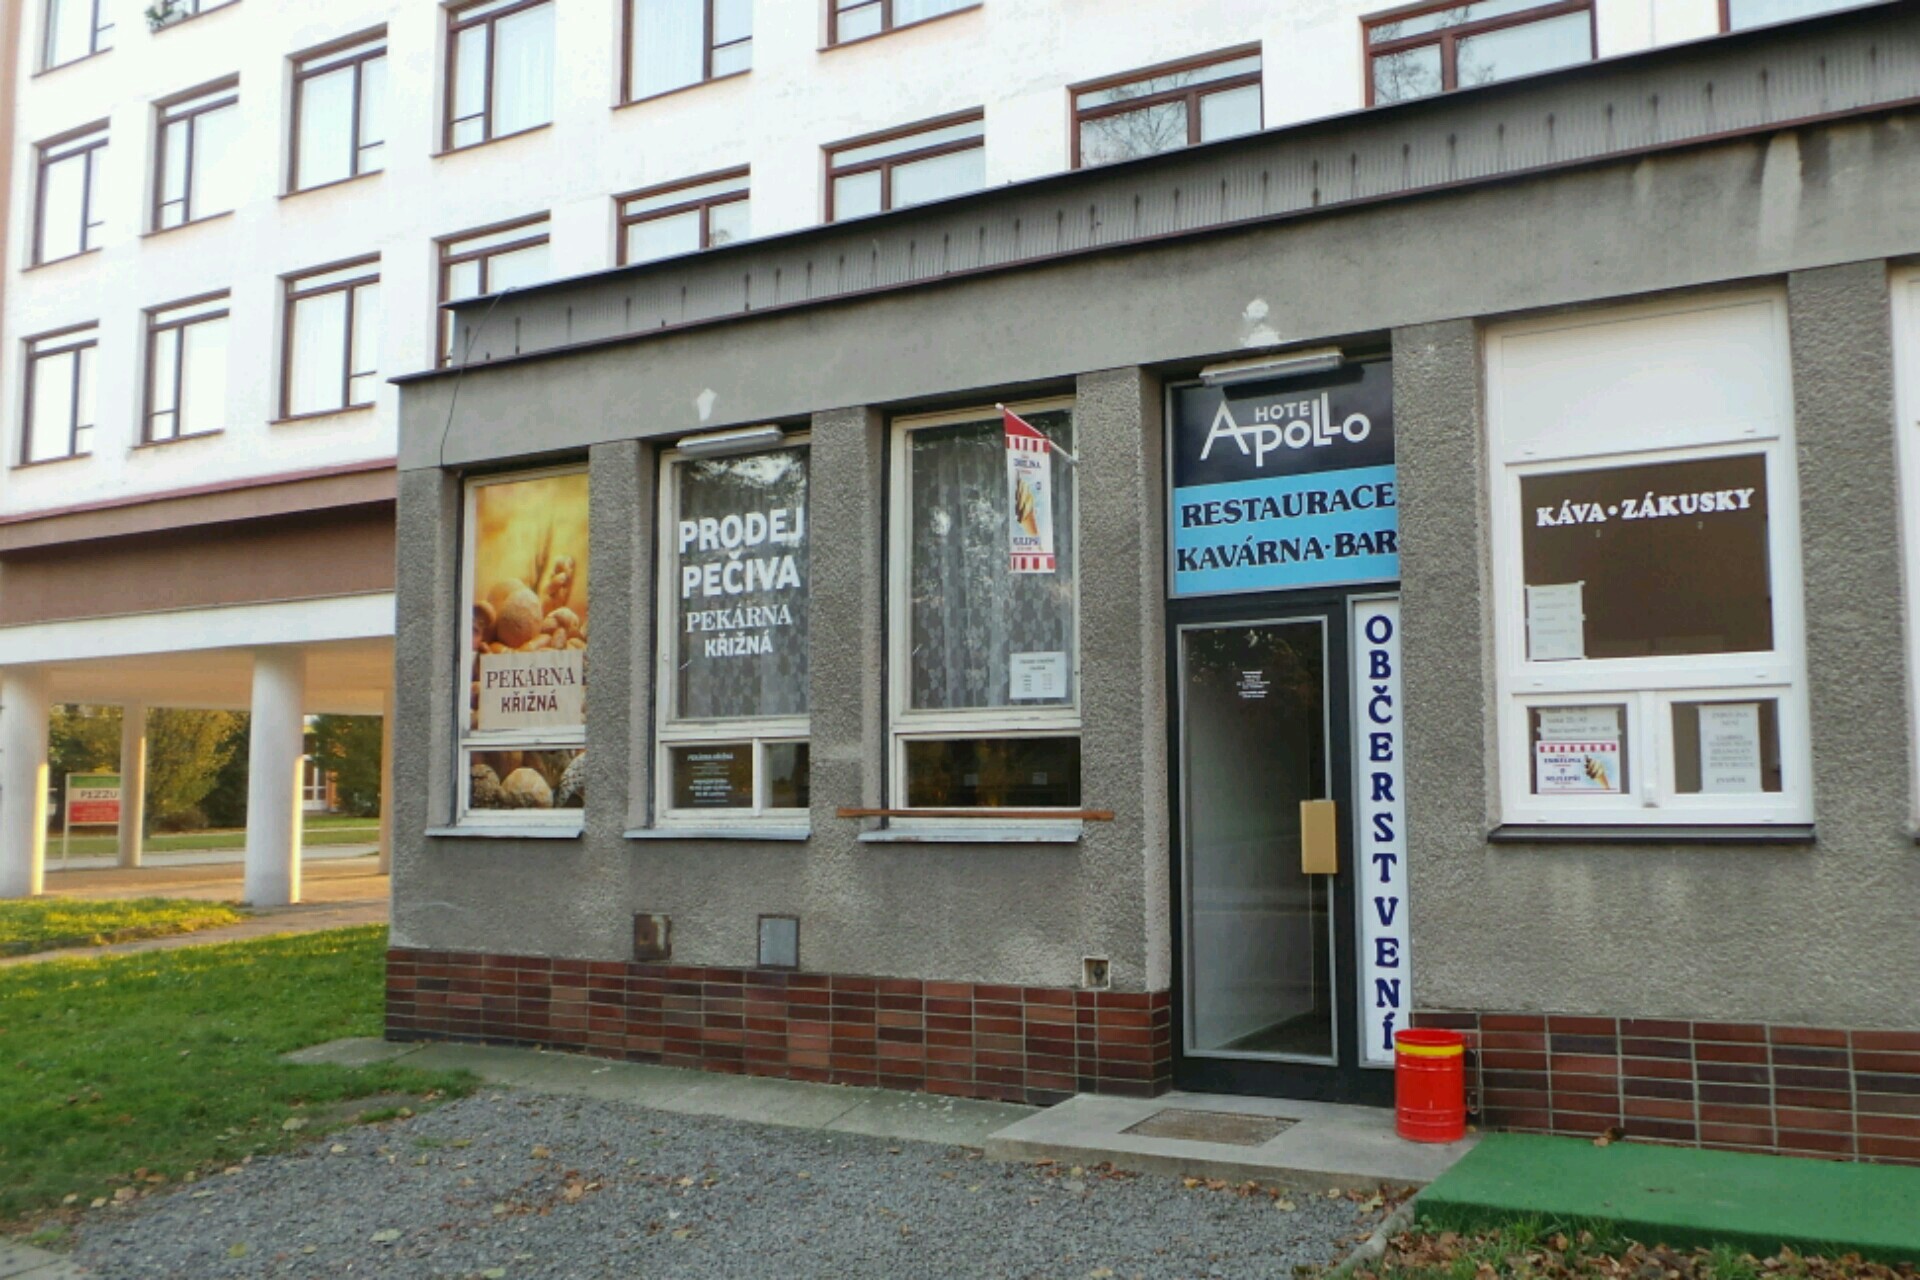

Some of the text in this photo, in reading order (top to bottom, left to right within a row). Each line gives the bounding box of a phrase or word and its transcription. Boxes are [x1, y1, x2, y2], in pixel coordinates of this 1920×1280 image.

[1181, 483, 1395, 527] RESTAURACE
[679, 507, 804, 553] PRODEJ
[682, 551, 801, 599] PEČIVA
[686, 603, 793, 633] PEKÁRNA
[704, 629, 774, 658] KŘIŽNÁ
[485, 664, 576, 689] PEKÁRNA
[500, 689, 558, 713] KŘIŽNÁ
[1365, 615, 1401, 1050] OBČERSTVENÍ
